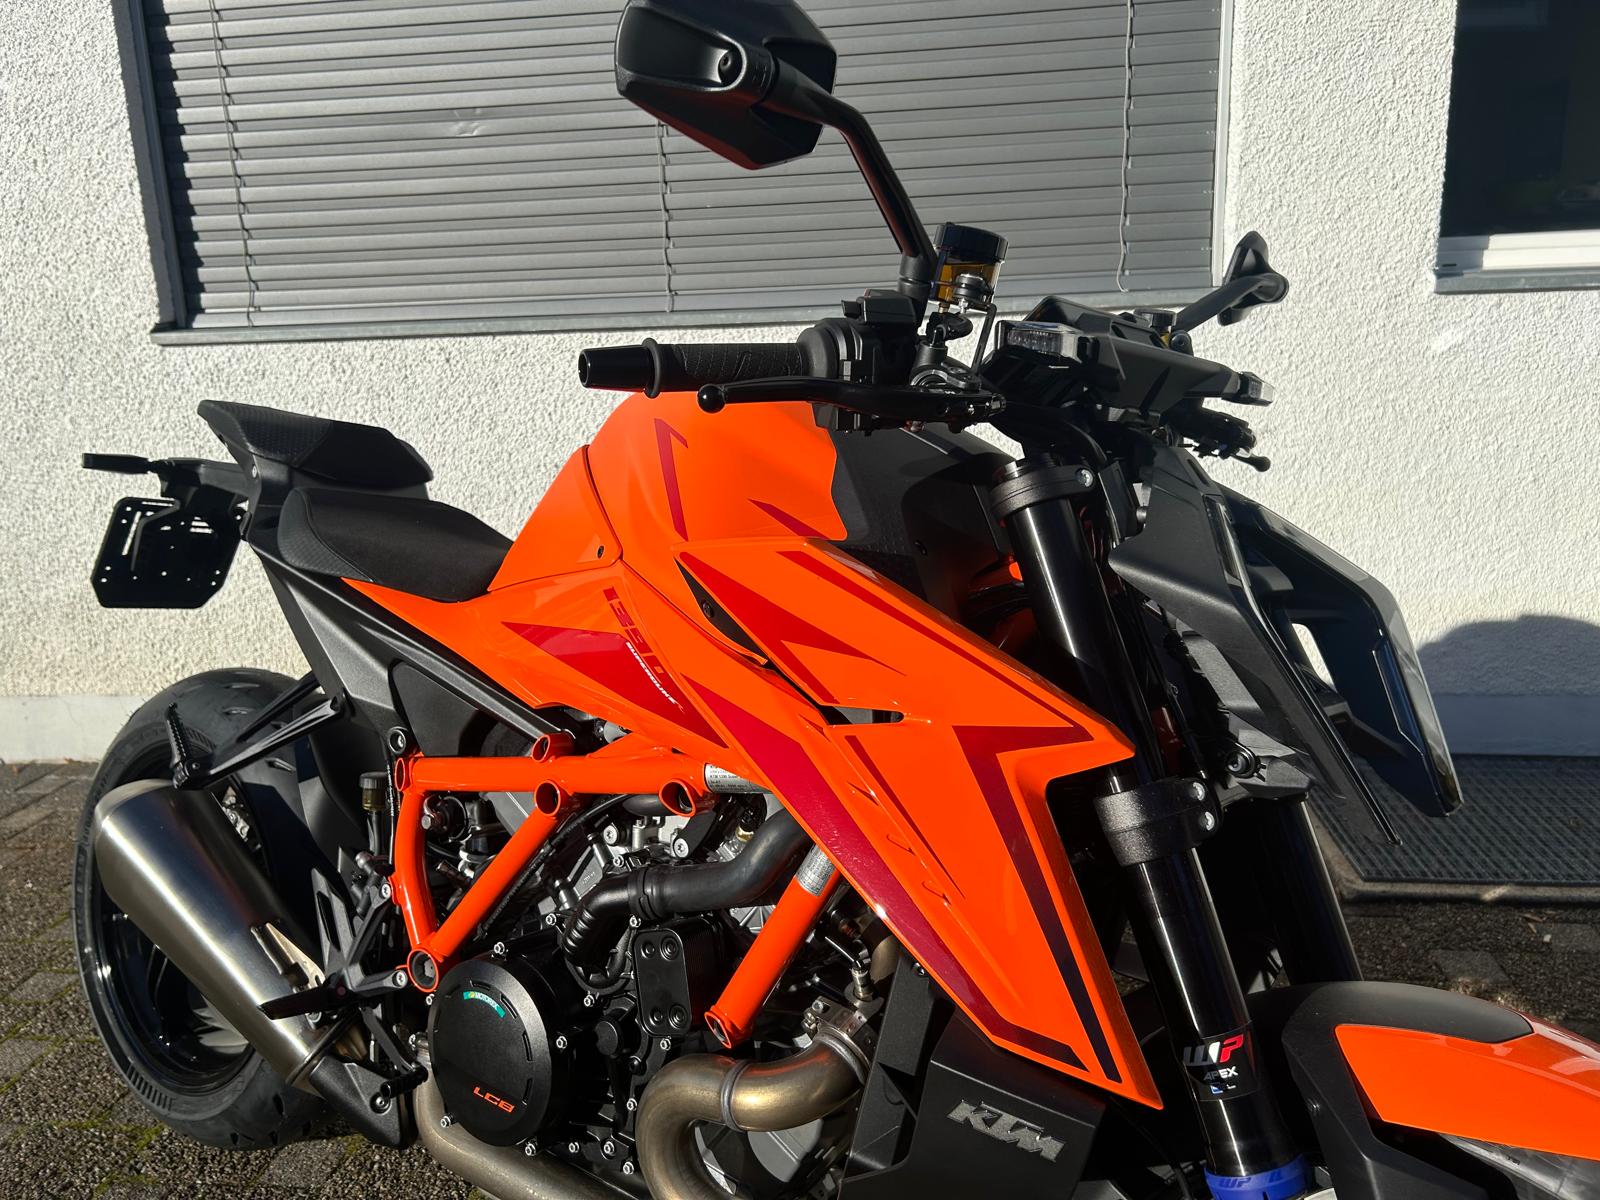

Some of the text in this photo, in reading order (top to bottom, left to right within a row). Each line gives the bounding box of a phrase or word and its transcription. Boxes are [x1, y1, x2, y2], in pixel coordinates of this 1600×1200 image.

[1183, 1034, 1244, 1066] WP
[1203, 1066, 1239, 1080] APEX
[473, 1087, 514, 1112] LC8
[946, 1100, 1064, 1162] KTM
